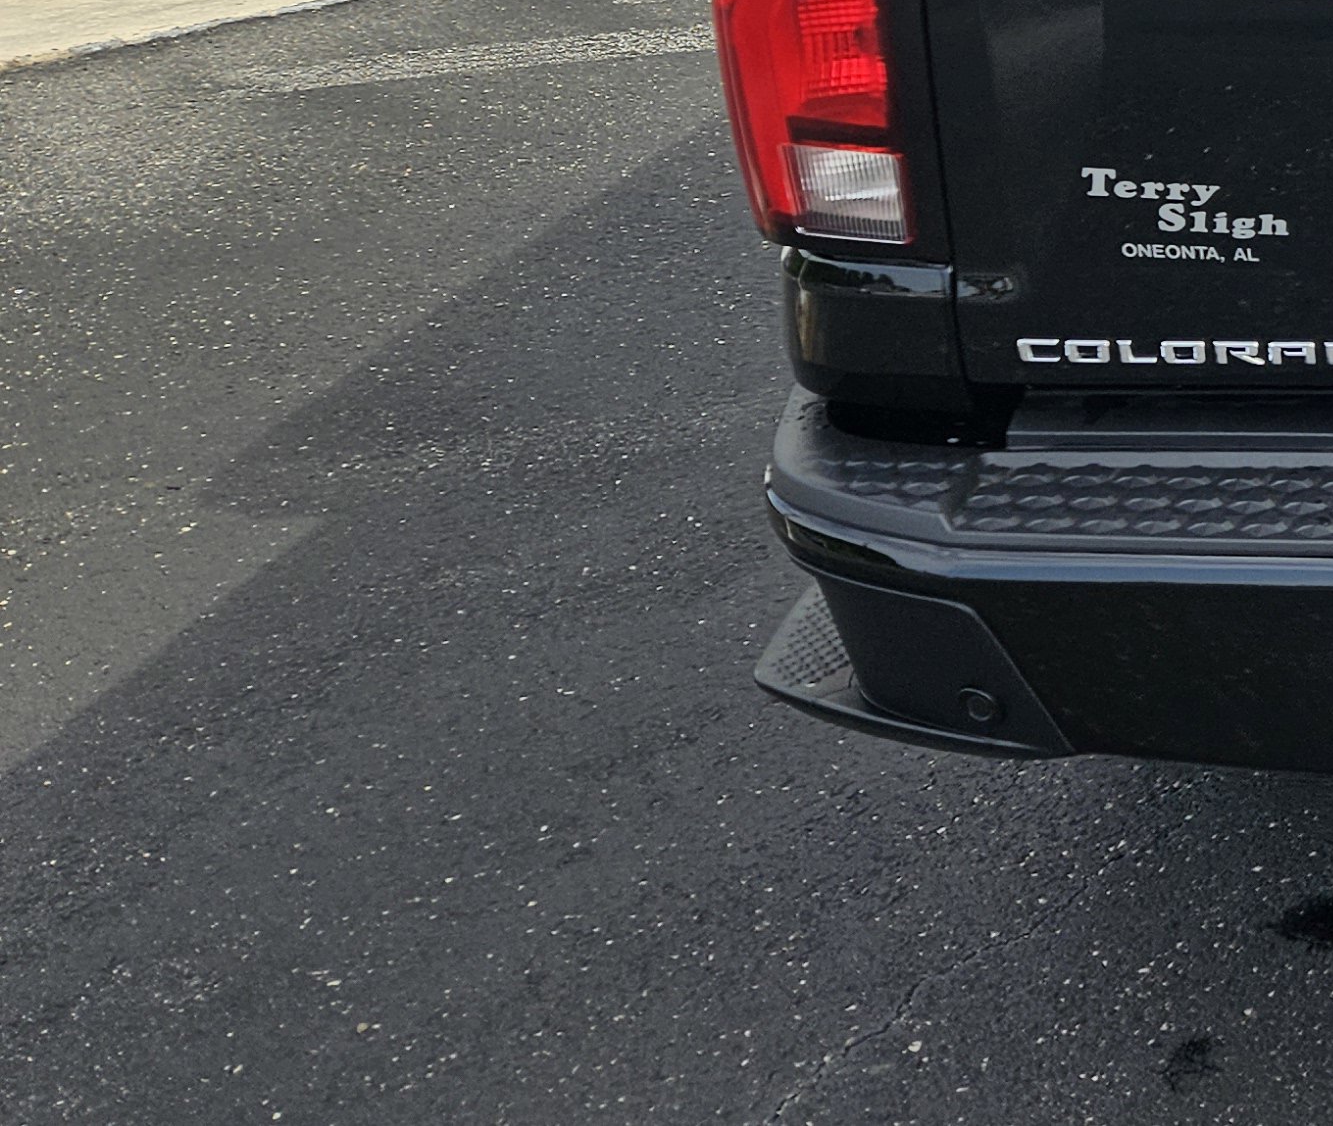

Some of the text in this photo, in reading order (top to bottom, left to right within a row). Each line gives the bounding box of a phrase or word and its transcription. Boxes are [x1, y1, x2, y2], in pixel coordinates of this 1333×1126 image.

[1081, 167, 1221, 206] Terry
[1157, 203, 1290, 240] Sligh
[1121, 243, 1260, 264] ONEONTA, AL
